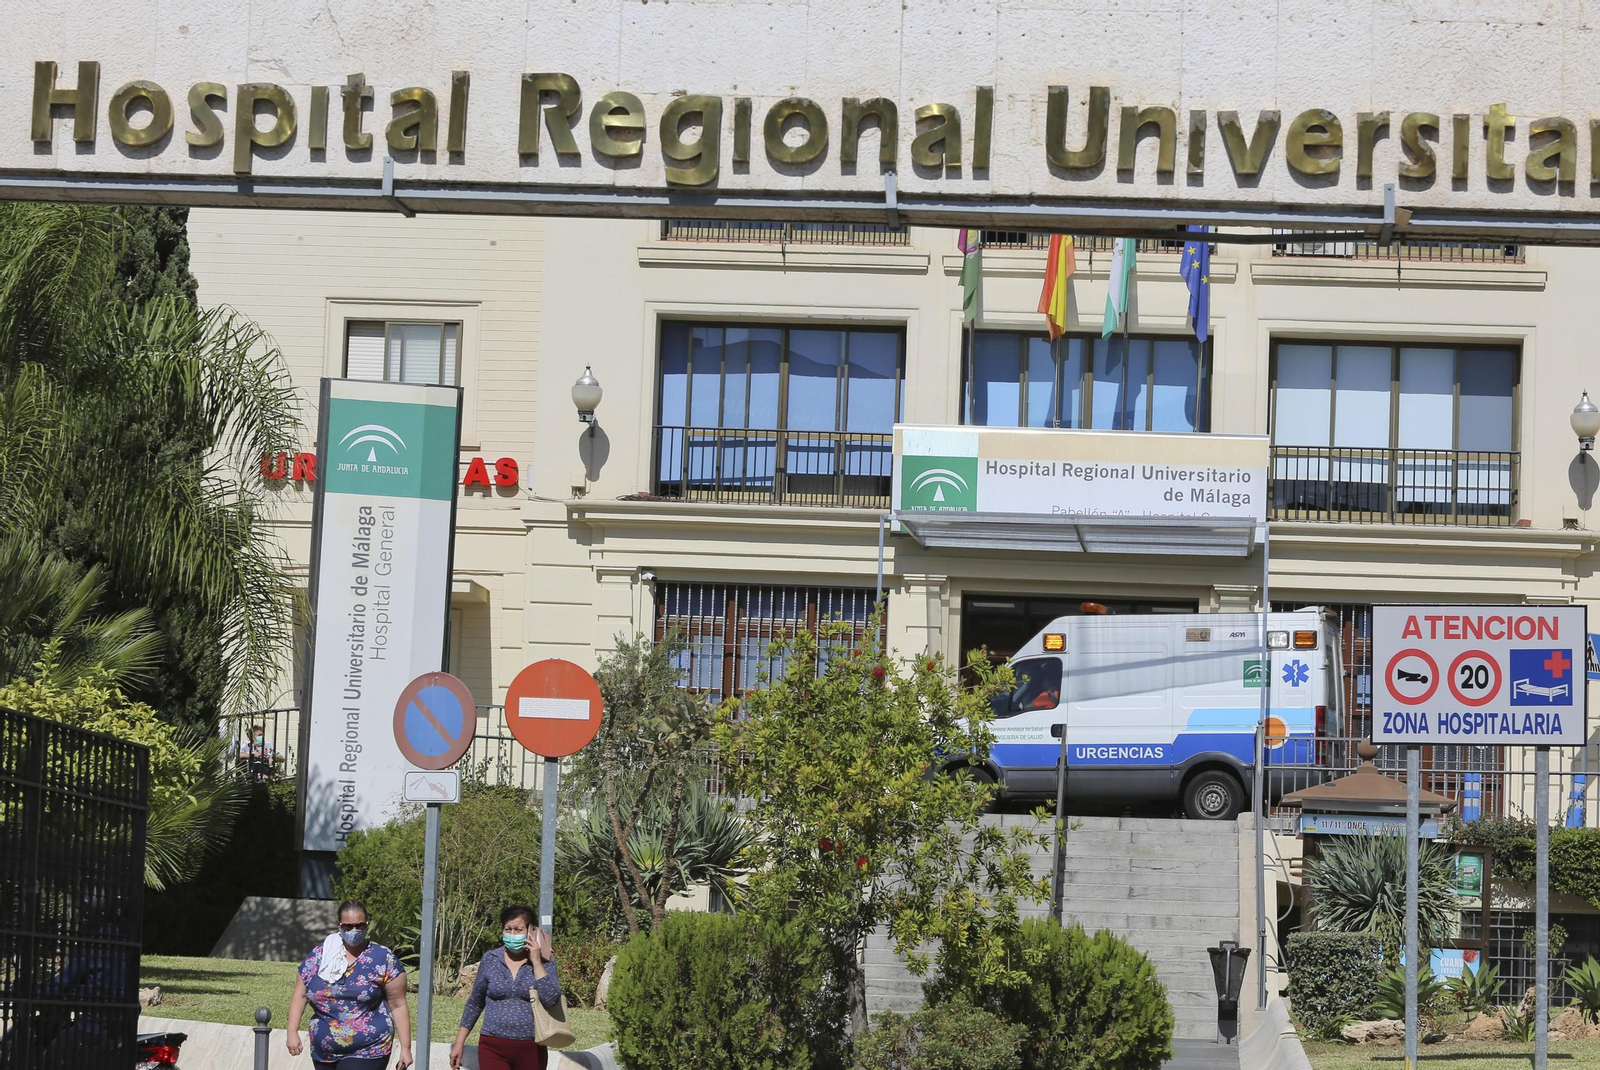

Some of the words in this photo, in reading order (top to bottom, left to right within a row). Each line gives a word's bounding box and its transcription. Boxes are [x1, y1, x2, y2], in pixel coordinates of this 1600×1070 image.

[31, 60, 470, 175] Hospital
[518, 72, 993, 187] Regional
[337, 462, 358, 472] JUNTA
[361, 464, 370, 473] DE
[985, 460, 1056, 479] Hospital
[1062, 462, 1135, 482] Regional
[1142, 465, 1252, 484] Universitario
[1163, 487, 1184, 502] de
[1190, 488, 1251, 508] Málaga
[352, 505, 376, 569] Málaga
[374, 505, 396, 576] General
[350, 575, 369, 596] de
[369, 585, 393, 660] Hospital
[1401, 615, 1559, 641] ATENCION
[343, 603, 366, 700] Universitario
[1460, 664, 1489, 690] 20
[1383, 711, 1429, 734] ZONA
[1438, 712, 1563, 735] HOSPITALARIA
[339, 707, 363, 773] Regional
[1076, 747, 1164, 759] URGENCIAS
[335, 780, 359, 842] Hospital
[1347, 821, 1367, 830] ONCE
